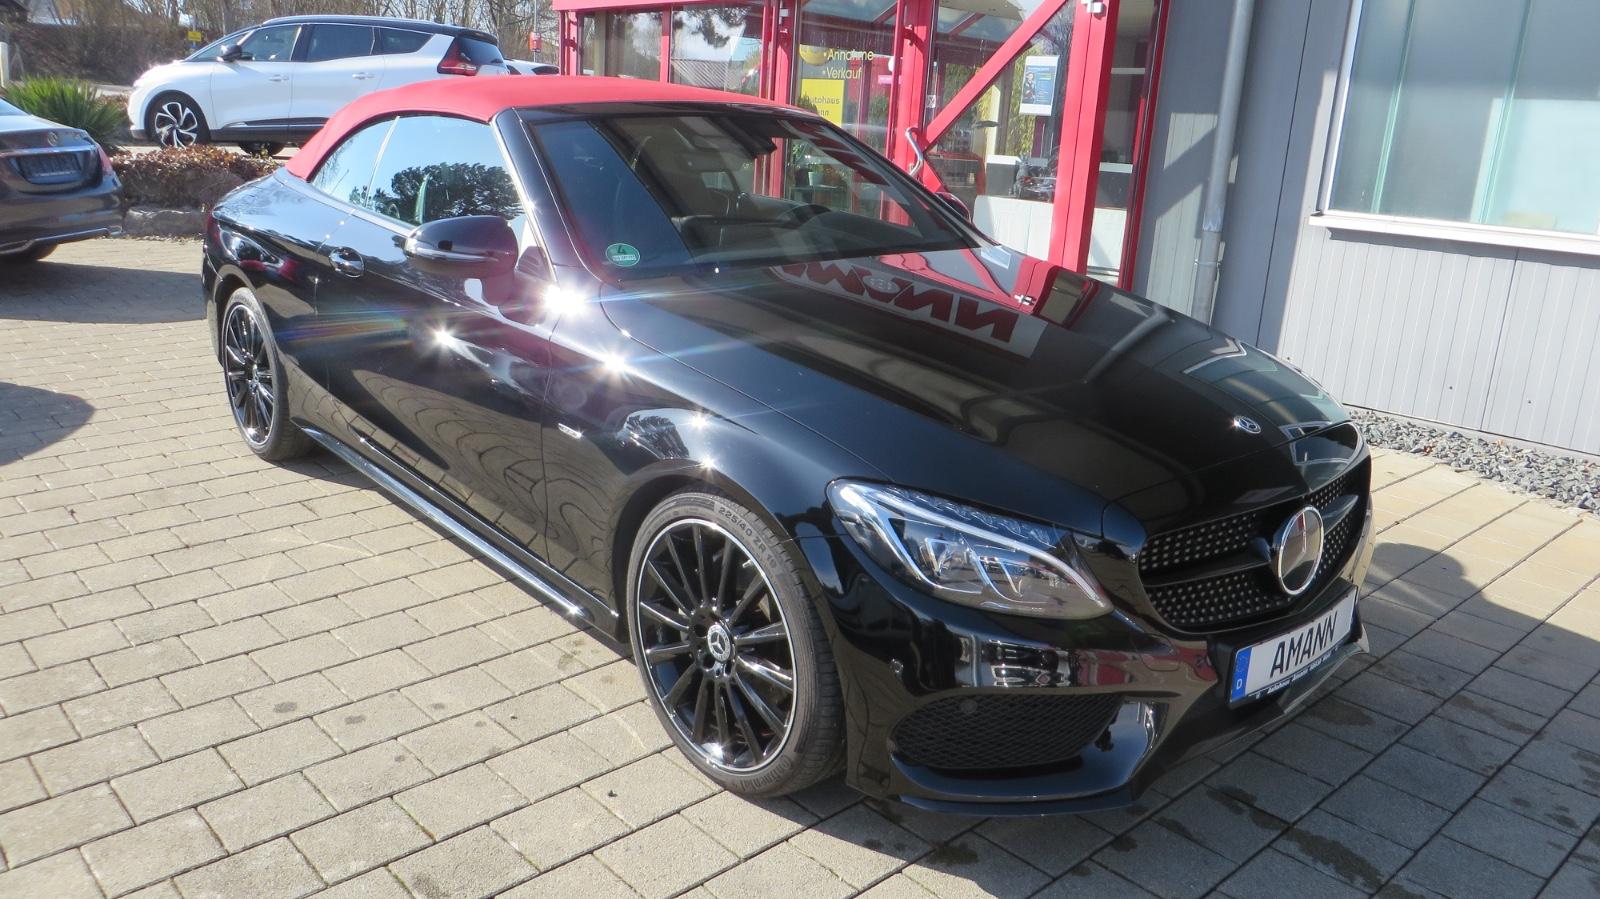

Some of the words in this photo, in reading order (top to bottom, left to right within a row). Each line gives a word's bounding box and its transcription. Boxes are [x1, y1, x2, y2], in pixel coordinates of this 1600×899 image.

[826, 67, 862, 79] Verkauf
[718, 507, 753, 537] 225/40
[1269, 611, 1338, 679] AMANN
[1236, 678, 1243, 690] D
